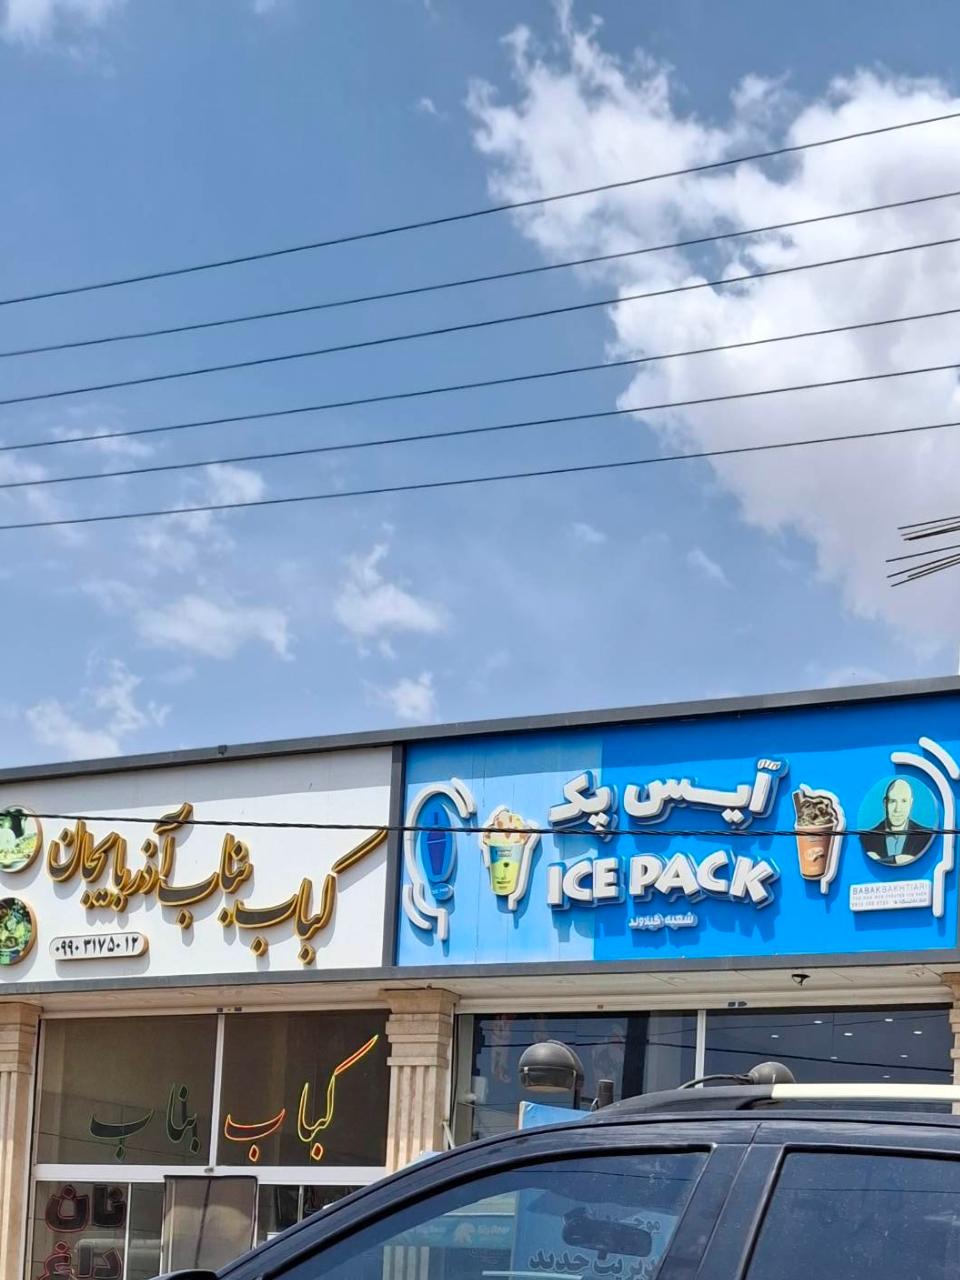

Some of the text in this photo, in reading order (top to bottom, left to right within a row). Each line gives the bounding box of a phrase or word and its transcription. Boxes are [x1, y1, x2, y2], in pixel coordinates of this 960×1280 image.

[549, 759, 782, 835] آیس پک
[47, 802, 388, 965] کباب بناب آذربایجان
[547, 850, 774, 906] ICE PACK
[89, 1034, 379, 1163] کباب بناب
[45, 1184, 127, 1233] نان
